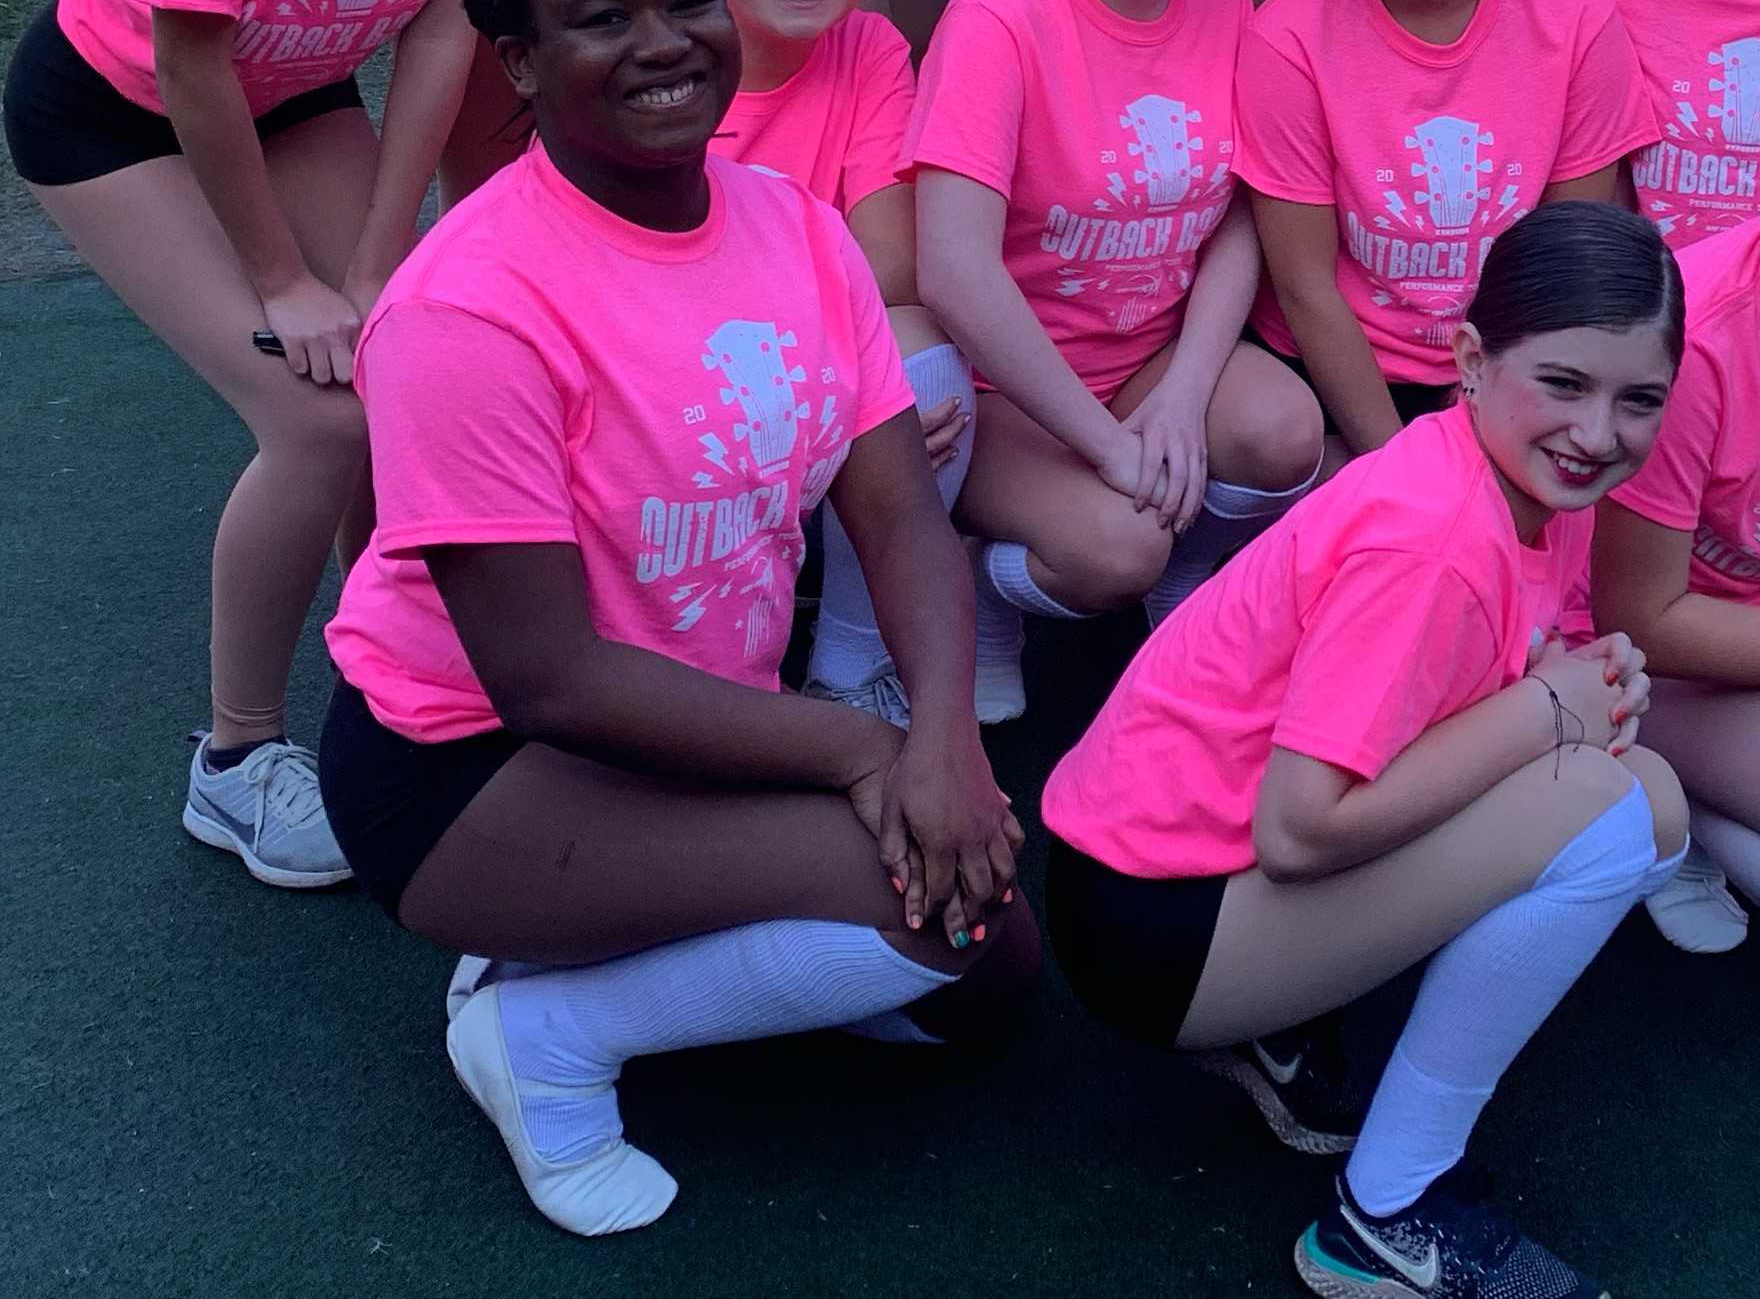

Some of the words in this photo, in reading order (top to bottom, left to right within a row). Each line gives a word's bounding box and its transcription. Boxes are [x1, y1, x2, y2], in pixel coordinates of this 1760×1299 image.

[1672, 80, 1690, 94] 20
[1219, 141, 1233, 153] 20
[1101, 150, 1117, 163] 20
[1376, 169, 1394, 182] 20
[1507, 162, 1522, 176] 20
[1632, 140, 1759, 197] OUTBACK
[1040, 204, 1174, 261] OUTBACK
[1347, 211, 1469, 280] OUTBACK
[683, 404, 705, 425] 20
[636, 480, 789, 584] OUTBACK
